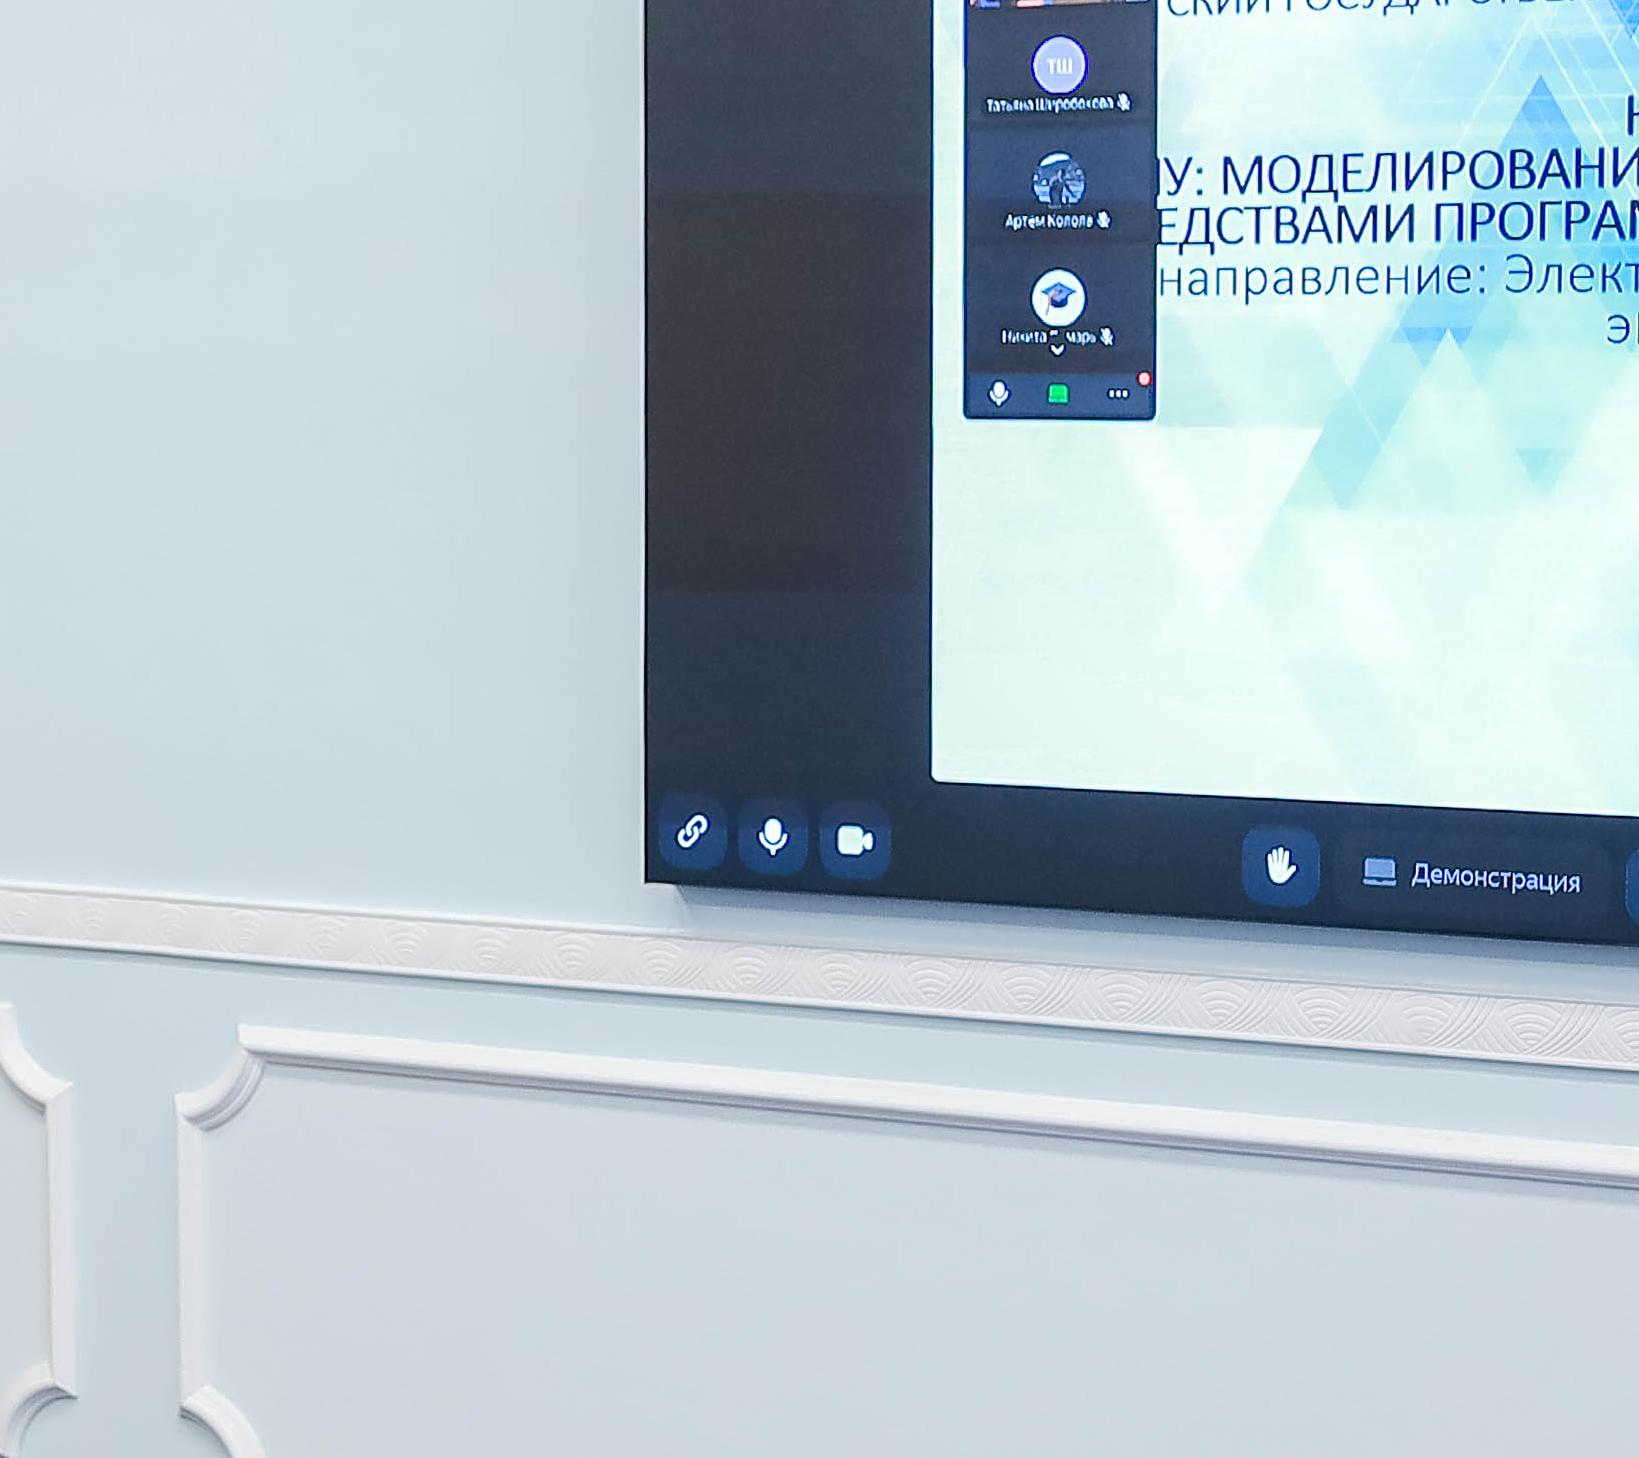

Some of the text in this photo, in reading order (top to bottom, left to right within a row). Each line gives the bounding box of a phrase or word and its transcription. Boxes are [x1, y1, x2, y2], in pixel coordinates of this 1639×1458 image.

[1047, 59, 1072, 74] ТШ
[1158, 156, 1203, 196] У:
[1158, 202, 1415, 255] ЕДСТВАМИ
[1160, 262, 1486, 304] направление:
[1411, 863, 1581, 896] Демонстрация
